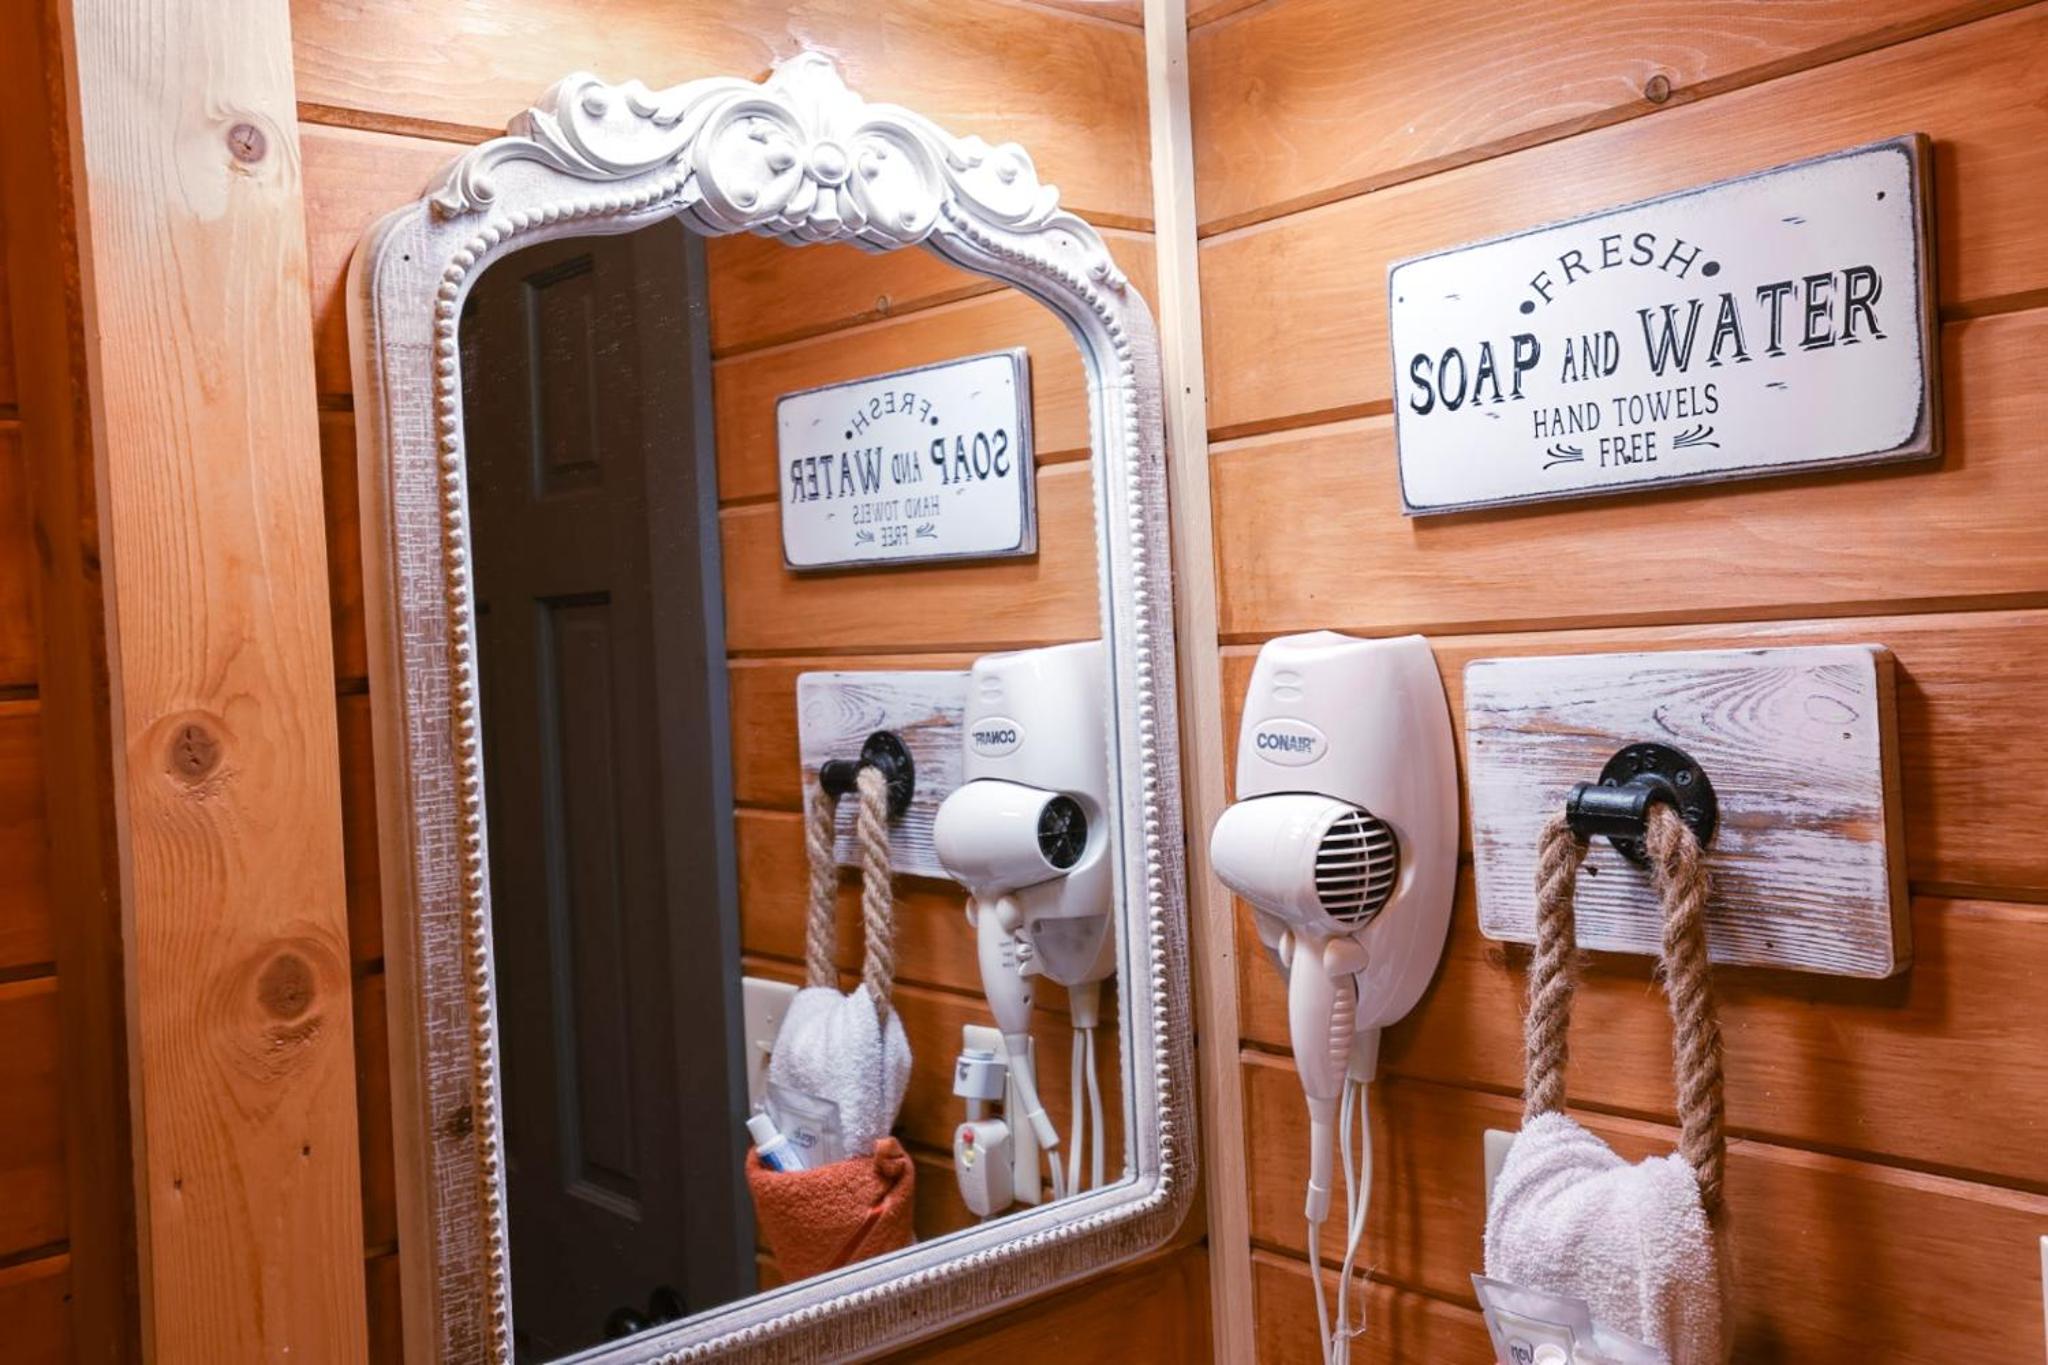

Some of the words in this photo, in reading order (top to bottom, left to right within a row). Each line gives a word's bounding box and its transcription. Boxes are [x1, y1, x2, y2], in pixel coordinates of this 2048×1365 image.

[1529, 232, 1703, 304] FRESH
[1409, 333, 1541, 416] SOAP
[1560, 330, 1620, 383] AND
[1636, 264, 1888, 378] WATER
[1532, 402, 1601, 439] HAND
[1612, 384, 1720, 428] TOWELS
[1599, 431, 1658, 468] FREE
[1256, 732, 1313, 753] CONAIR
